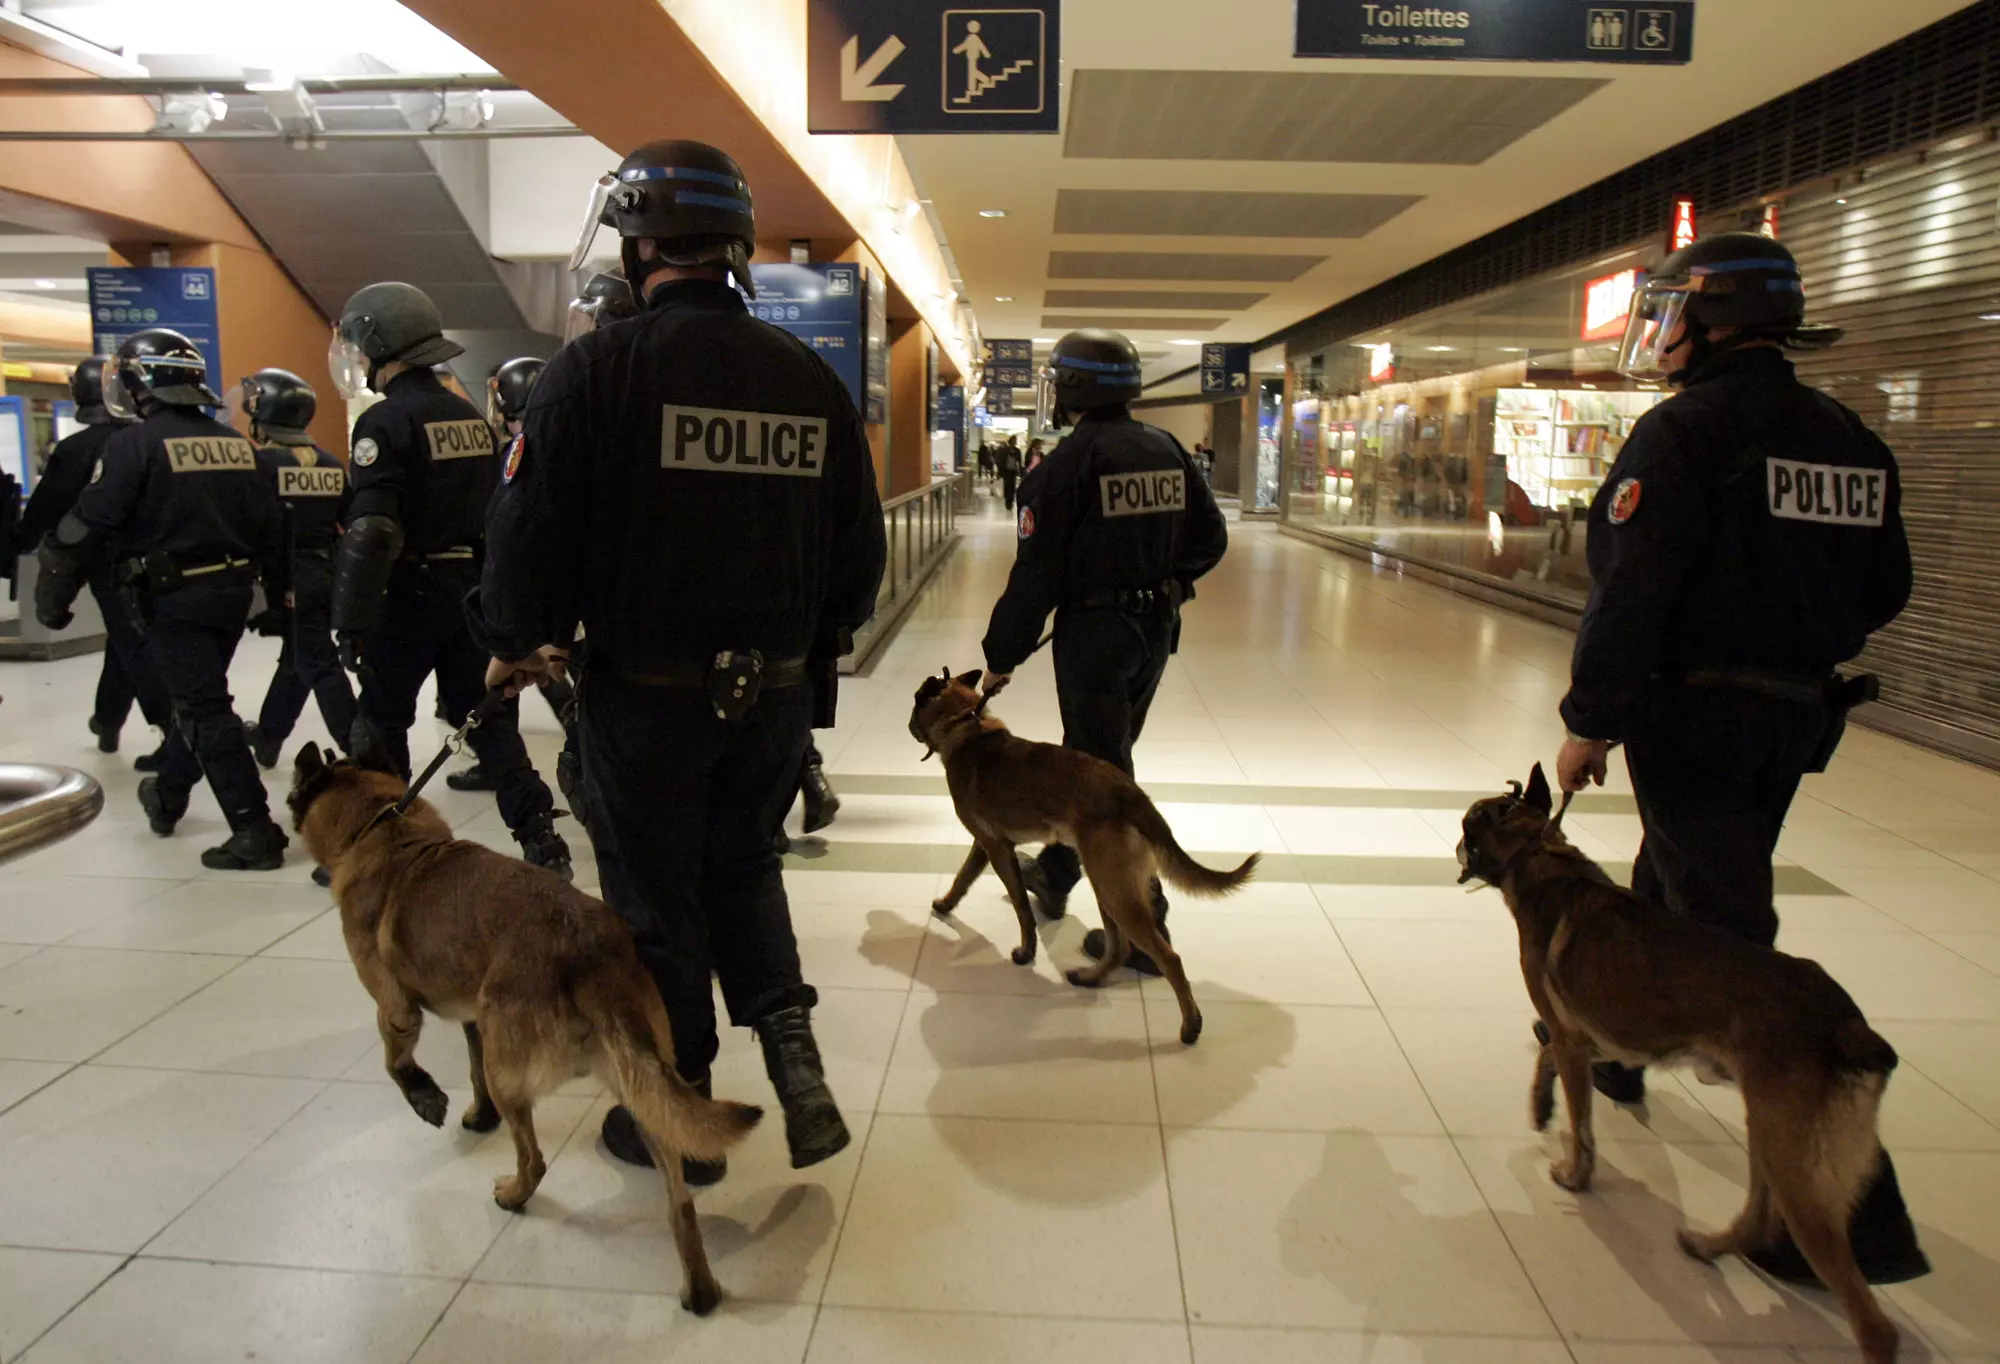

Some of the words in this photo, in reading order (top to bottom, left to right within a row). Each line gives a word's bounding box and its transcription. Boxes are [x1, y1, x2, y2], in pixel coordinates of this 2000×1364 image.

[1361, 4, 1470, 28] Toilettes
[831, 278, 850, 292] 42
[172, 439, 251, 467] POLICE
[432, 423, 491, 454] POLICE
[674, 413, 820, 470] POLICE
[284, 470, 342, 493] POLICE
[1107, 474, 1182, 512] POLICE
[1773, 465, 1880, 518] POLICE
